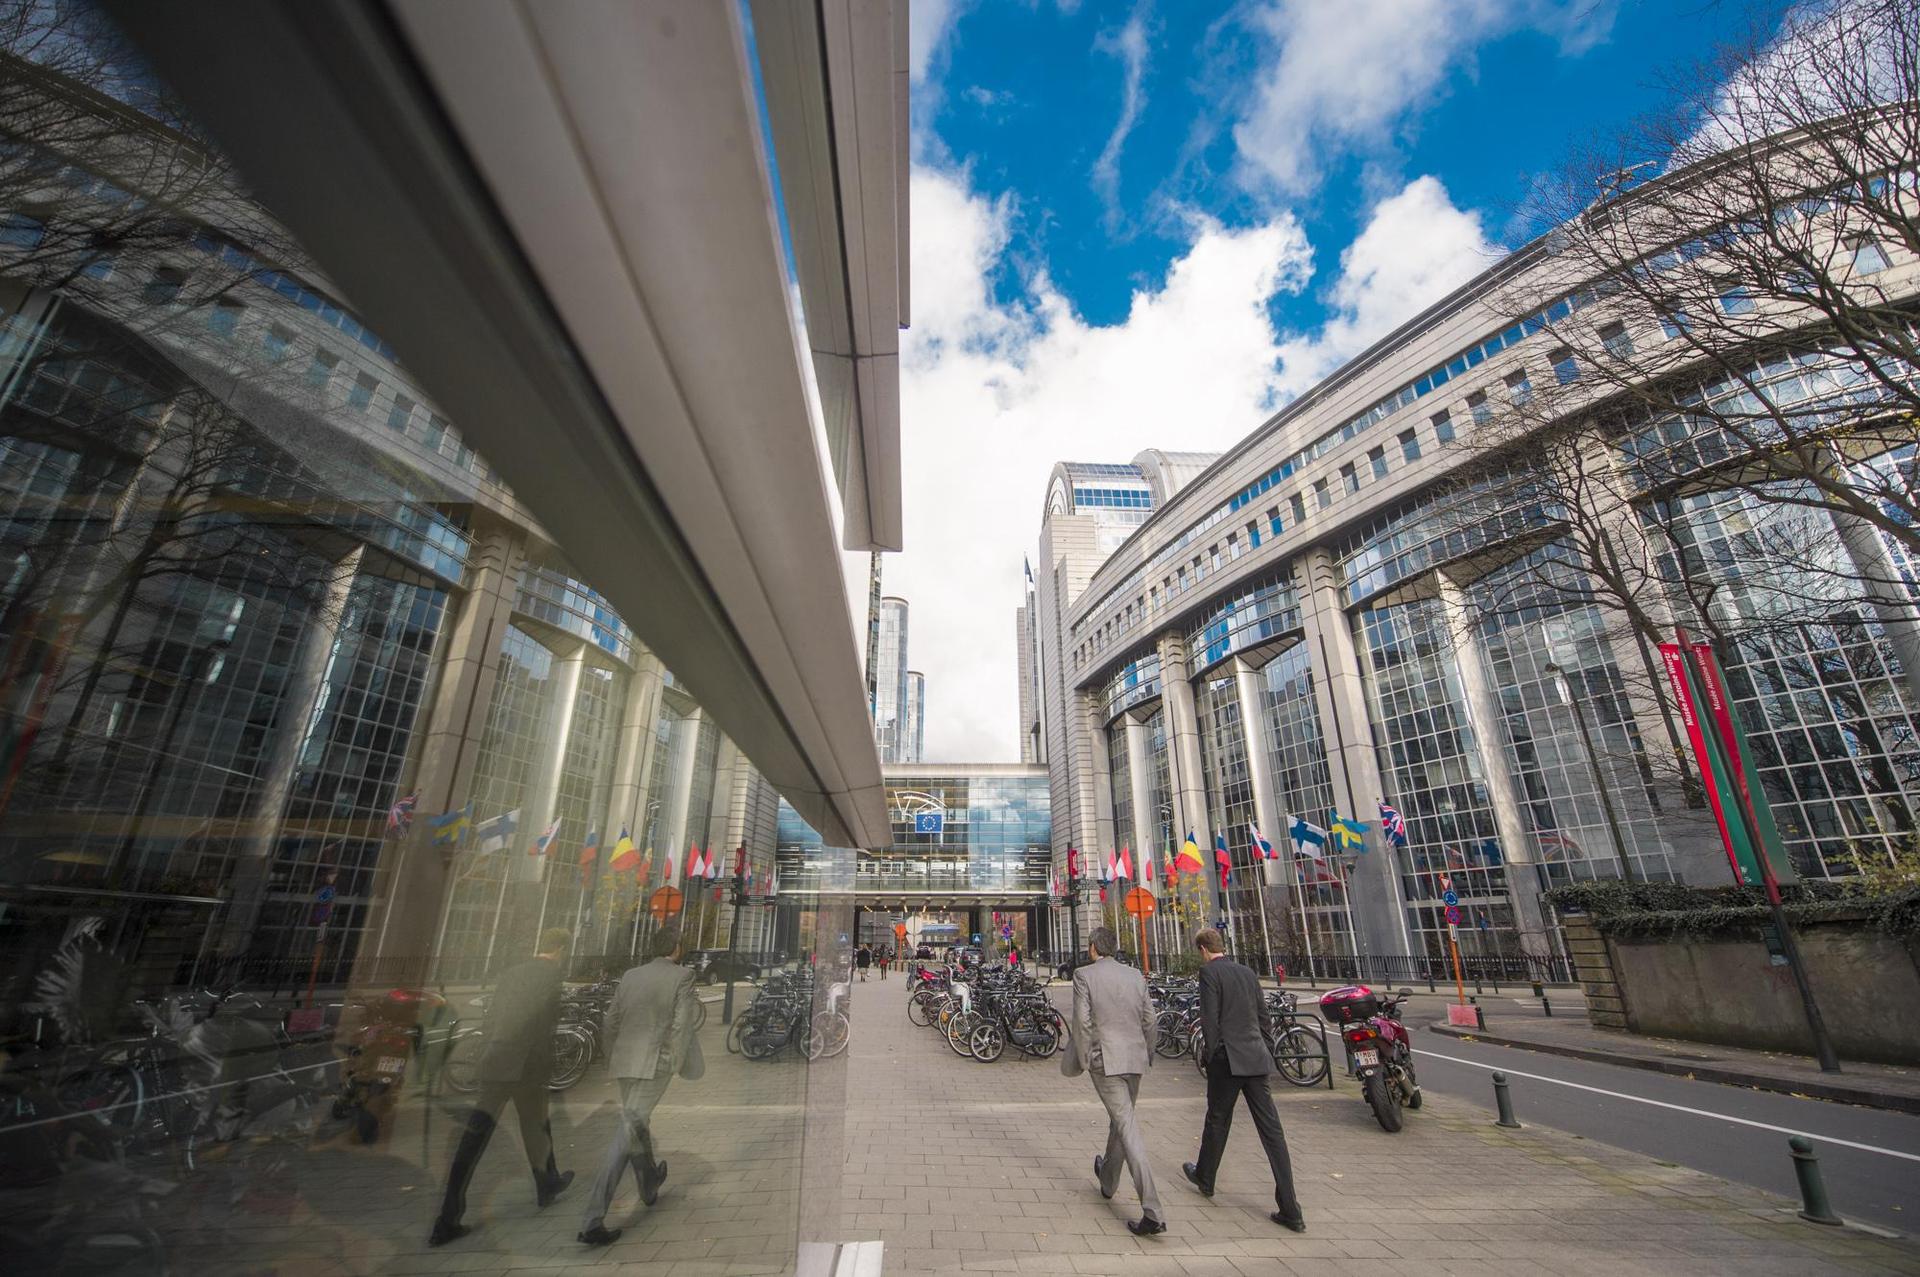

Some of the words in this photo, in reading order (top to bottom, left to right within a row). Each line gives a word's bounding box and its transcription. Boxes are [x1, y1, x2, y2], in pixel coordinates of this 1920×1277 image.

[1664, 652, 1676, 674] Wiertz
[1672, 675, 1687, 702] Antoine
[1702, 666, 1715, 690] Antoine
[1682, 703, 1694, 726] Musée
